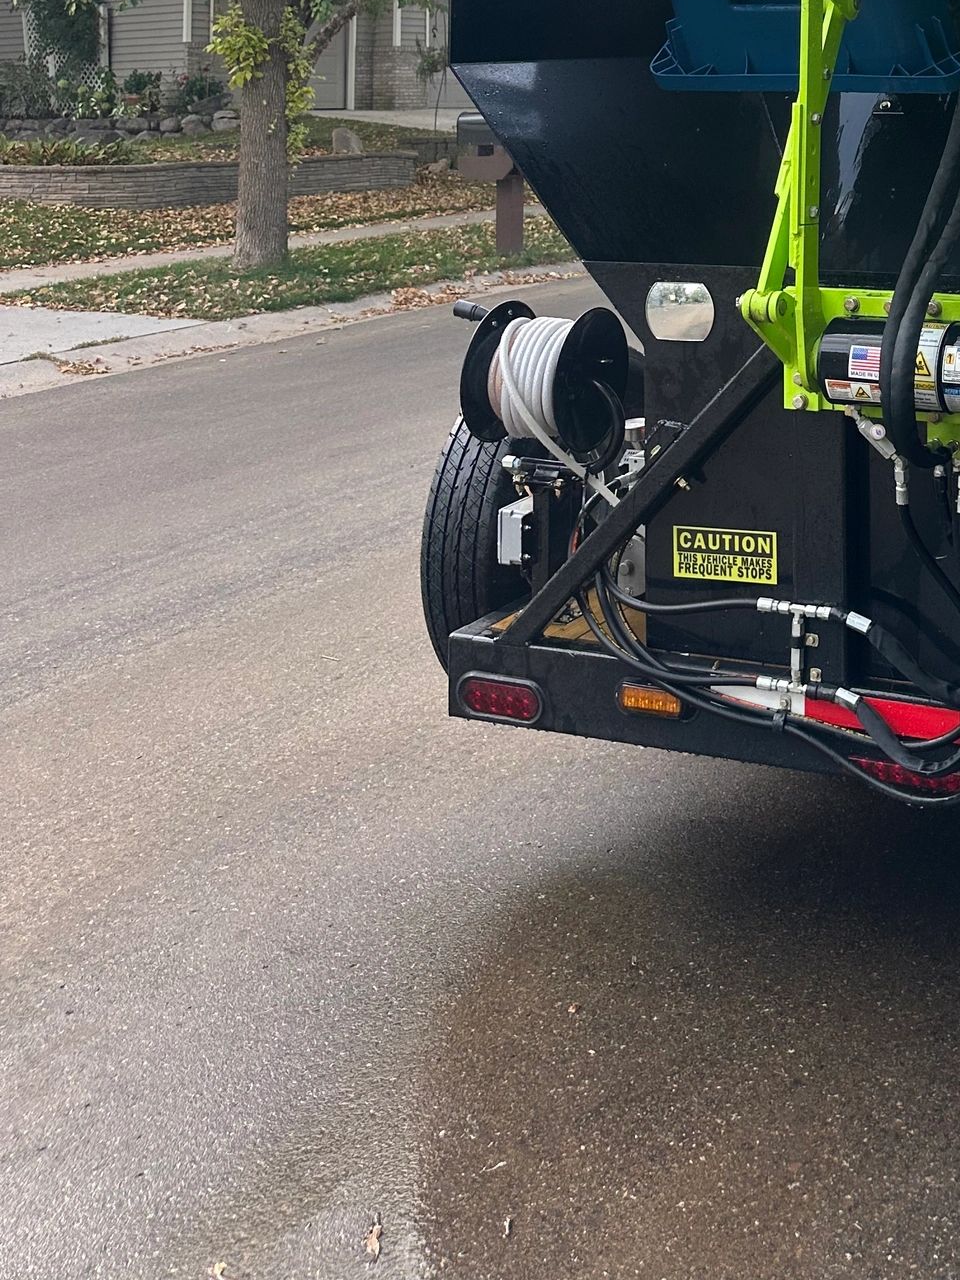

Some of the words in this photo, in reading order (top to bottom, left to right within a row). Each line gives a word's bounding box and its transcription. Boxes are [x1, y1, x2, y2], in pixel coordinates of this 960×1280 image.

[680, 531, 771, 554] CAUTION
[678, 552, 698, 563] THIS
[701, 554, 738, 566] VEHICLE
[741, 557, 773, 569] MAKES
[678, 562, 734, 577] FREQUENT
[737, 566, 772, 580] STOPS
